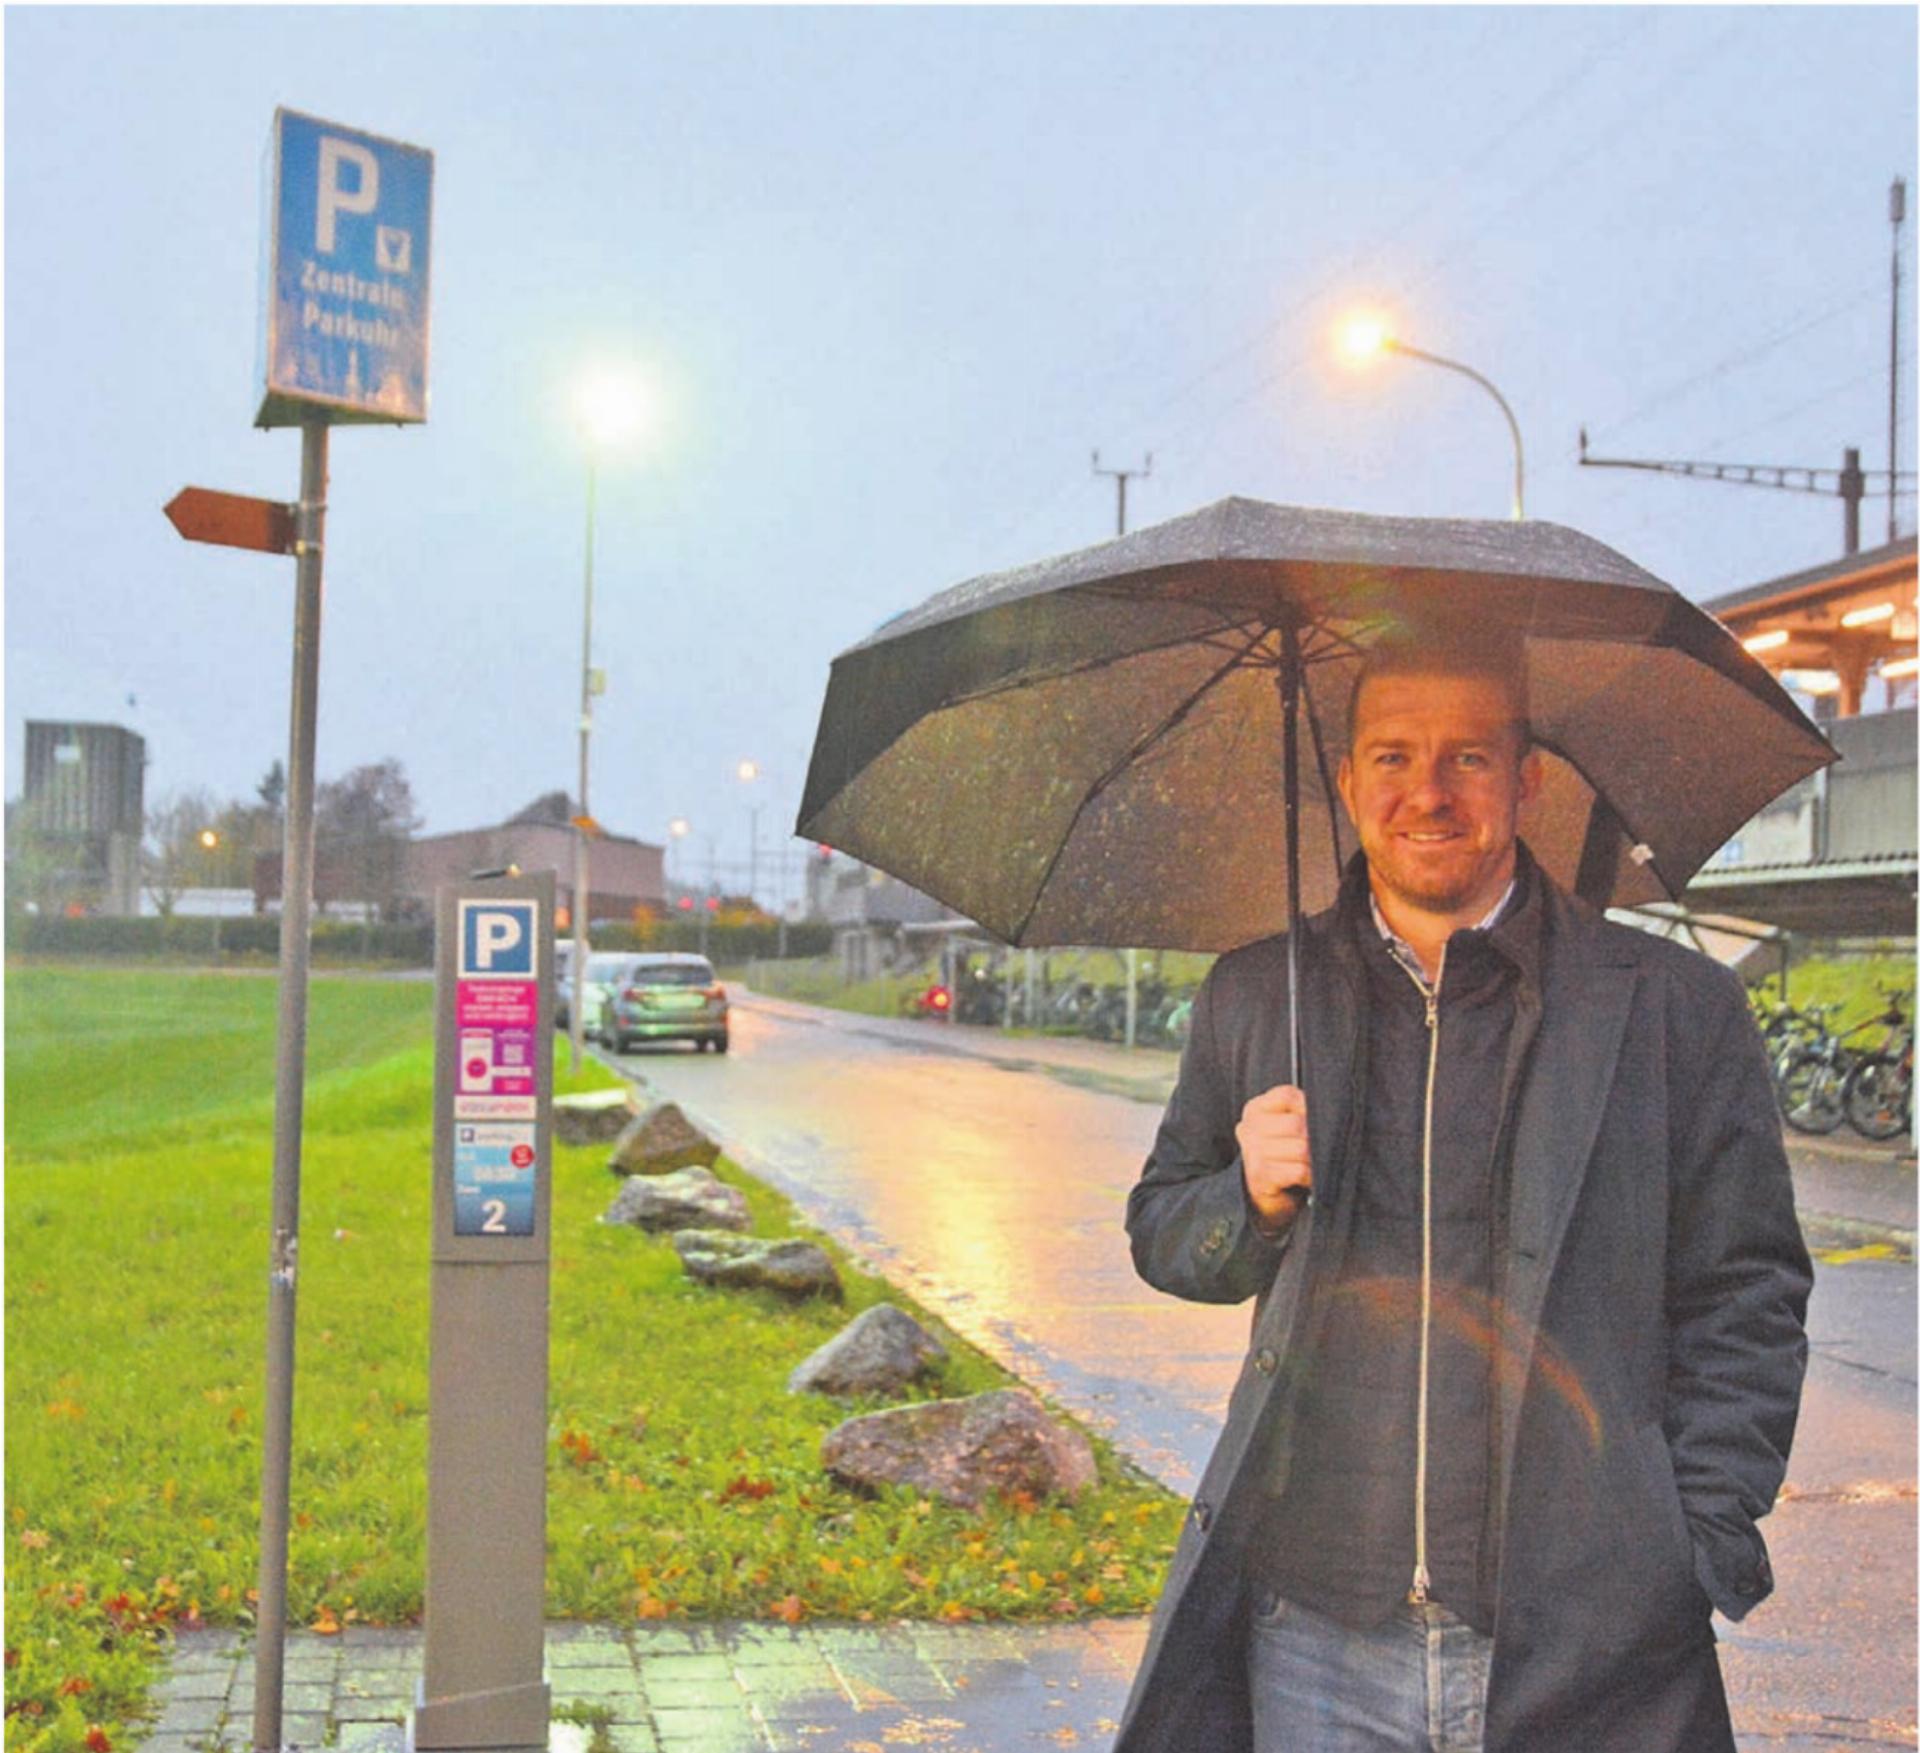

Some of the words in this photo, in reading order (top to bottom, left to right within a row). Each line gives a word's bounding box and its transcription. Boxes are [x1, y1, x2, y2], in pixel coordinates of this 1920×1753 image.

[316, 136, 379, 254] P
[303, 299, 402, 347] Parkuhr
[475, 912, 522, 969] P
[482, 1199, 507, 1234] 2
